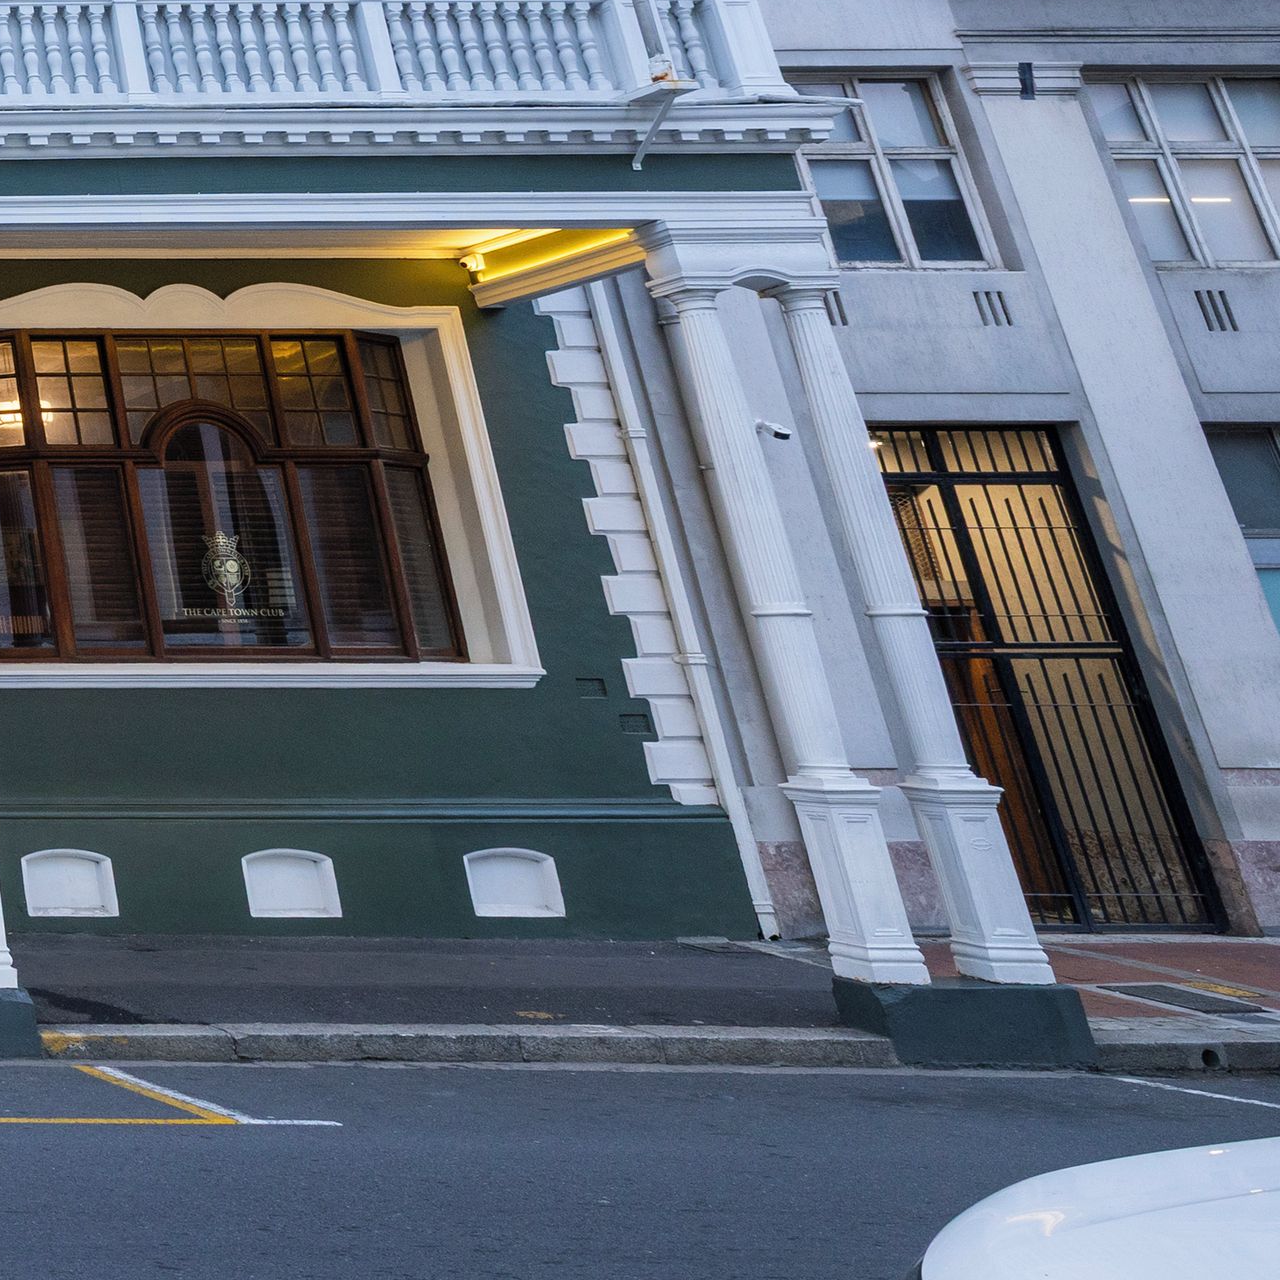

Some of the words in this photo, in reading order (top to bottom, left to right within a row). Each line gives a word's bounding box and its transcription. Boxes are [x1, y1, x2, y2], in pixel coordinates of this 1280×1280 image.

[183, 608, 201, 616] THE
[203, 608, 227, 616] CAPE
[228, 608, 258, 616] TOWN
[260, 608, 284, 616] CLUB
